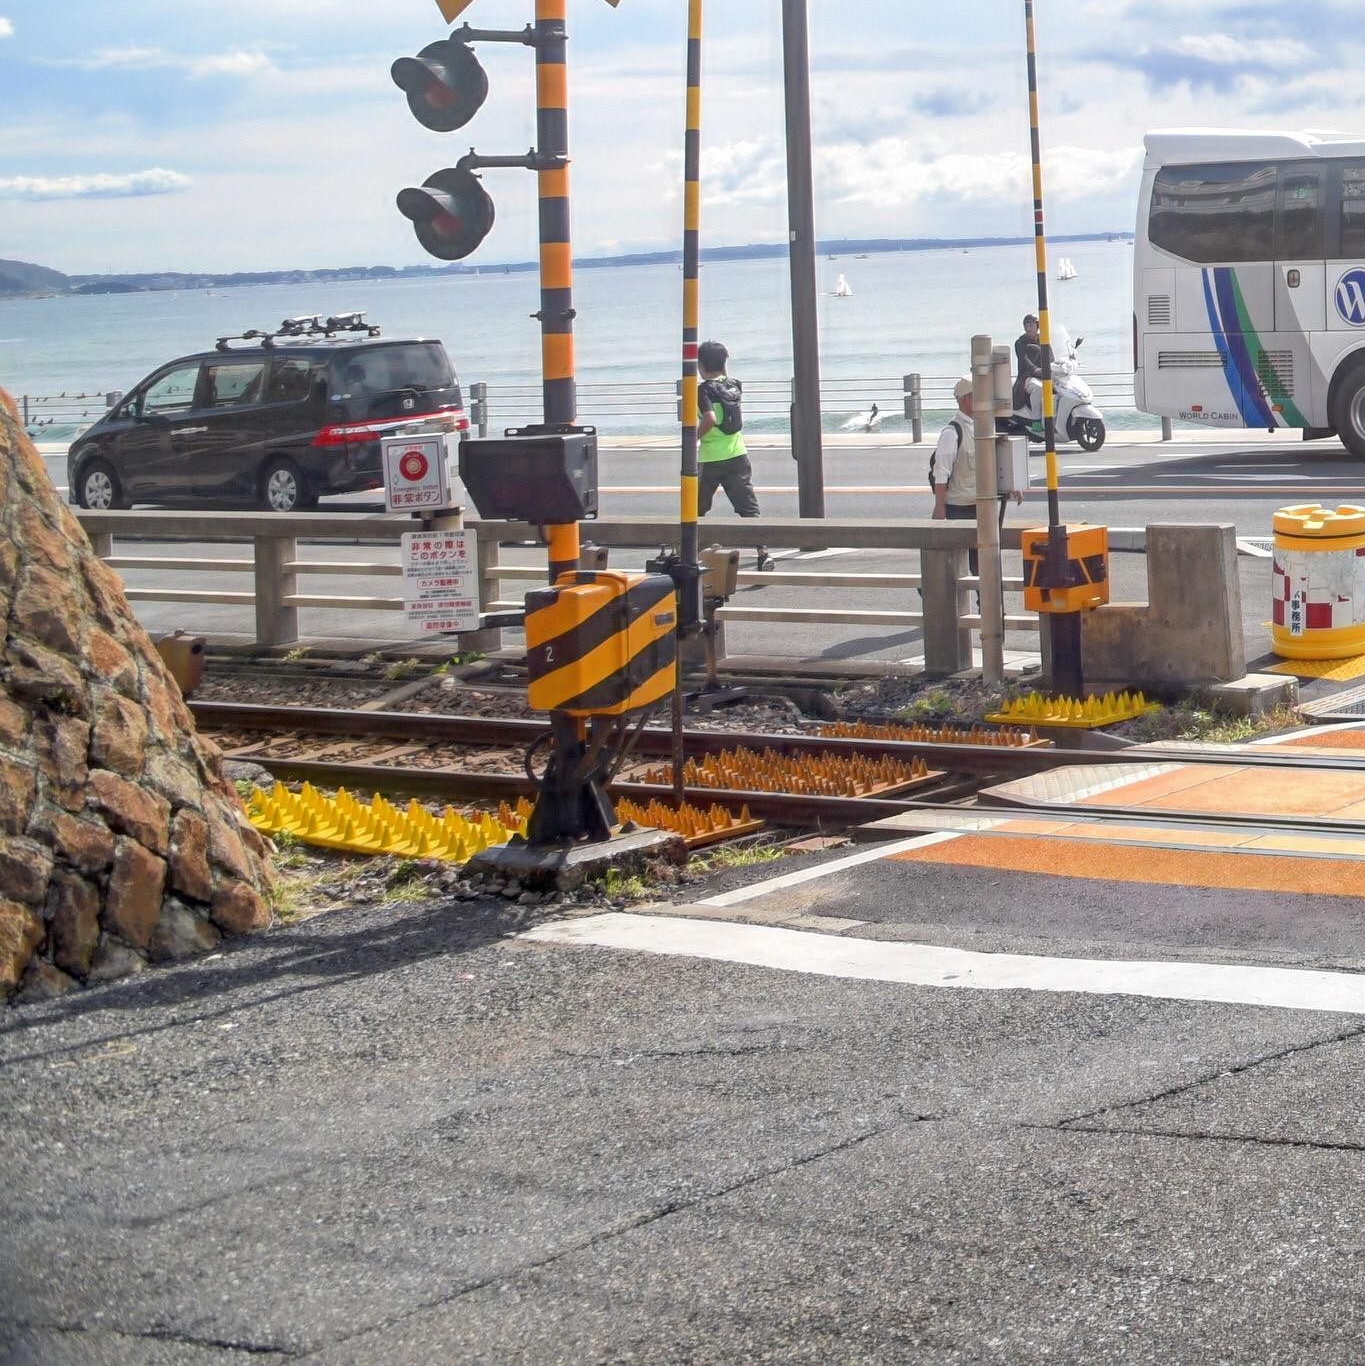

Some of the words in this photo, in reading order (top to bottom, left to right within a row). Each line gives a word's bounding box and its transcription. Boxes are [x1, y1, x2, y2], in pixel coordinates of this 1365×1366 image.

[1179, 412, 1208, 420] WORLD
[1211, 412, 1238, 420] CABIN
[393, 491, 439, 504] 非常ボタン
[411, 541, 464, 551] 非常の際は
[411, 550, 466, 560] このボタンを
[545, 646, 554, 662] 2
